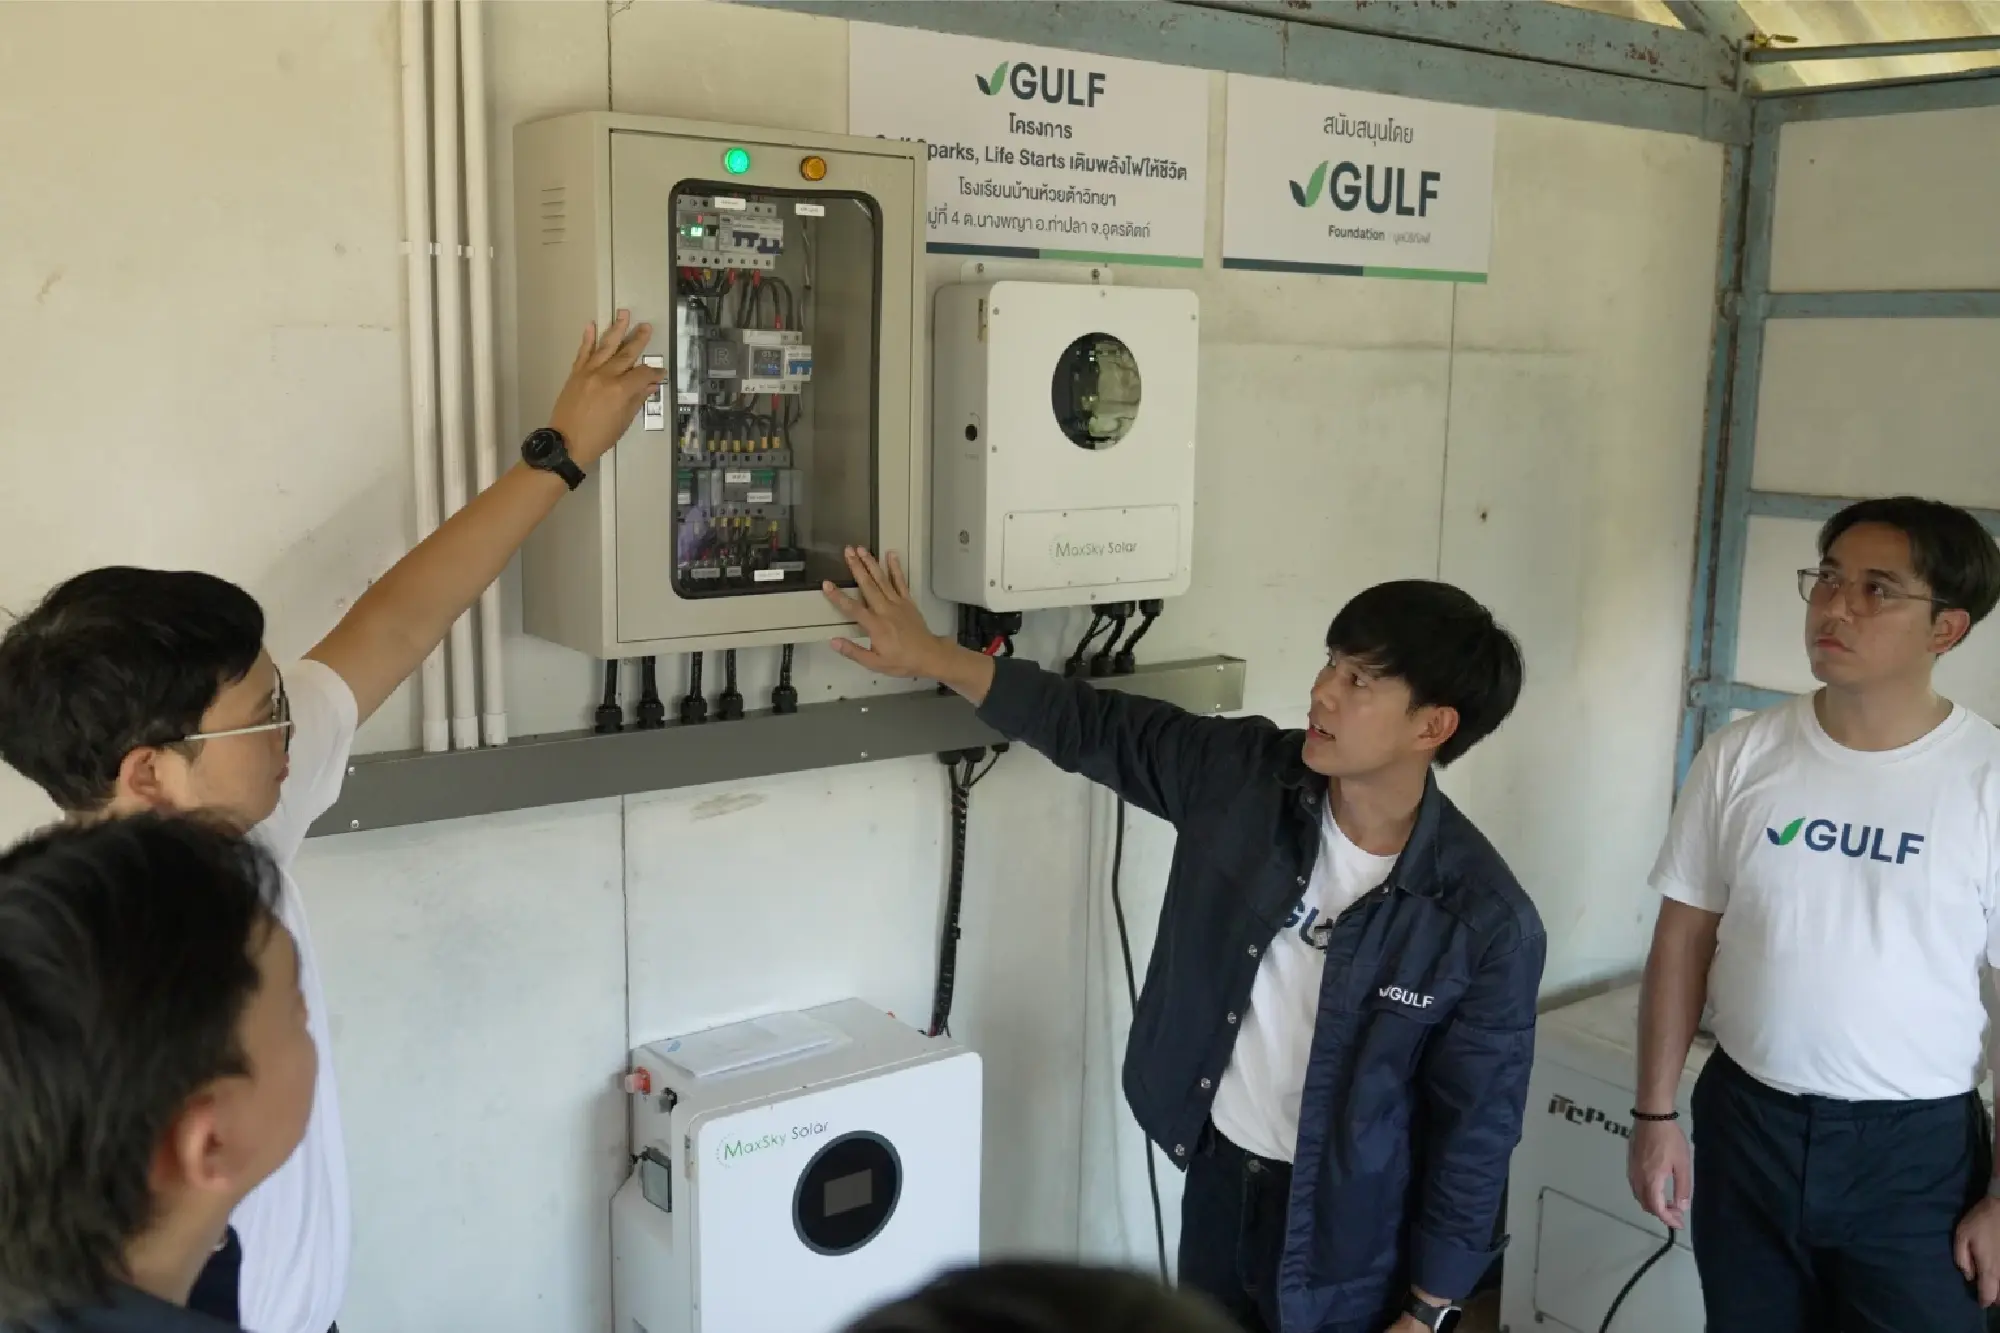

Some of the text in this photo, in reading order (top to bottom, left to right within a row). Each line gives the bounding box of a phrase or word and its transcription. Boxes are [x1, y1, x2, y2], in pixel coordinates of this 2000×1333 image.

[1009, 61, 1106, 108] GULF
[1008, 112, 1073, 140] โครงการ
[1323, 112, 1414, 147] สนับสนุนโดย
[926, 142, 980, 165] parks,
[985, 145, 1014, 165] Life
[1019, 147, 1066, 170] Starts
[1329, 160, 1441, 217] GULF
[926, 202, 948, 229] มู่ที่
[951, 210, 961, 226] 4
[1328, 224, 1385, 241] Foundation
[1055, 540, 1138, 558] MaxSky Solar
[1805, 818, 1925, 865] GULF
[1388, 986, 1435, 1009] GULF
[723, 1119, 830, 1161] MaxSky Solar
